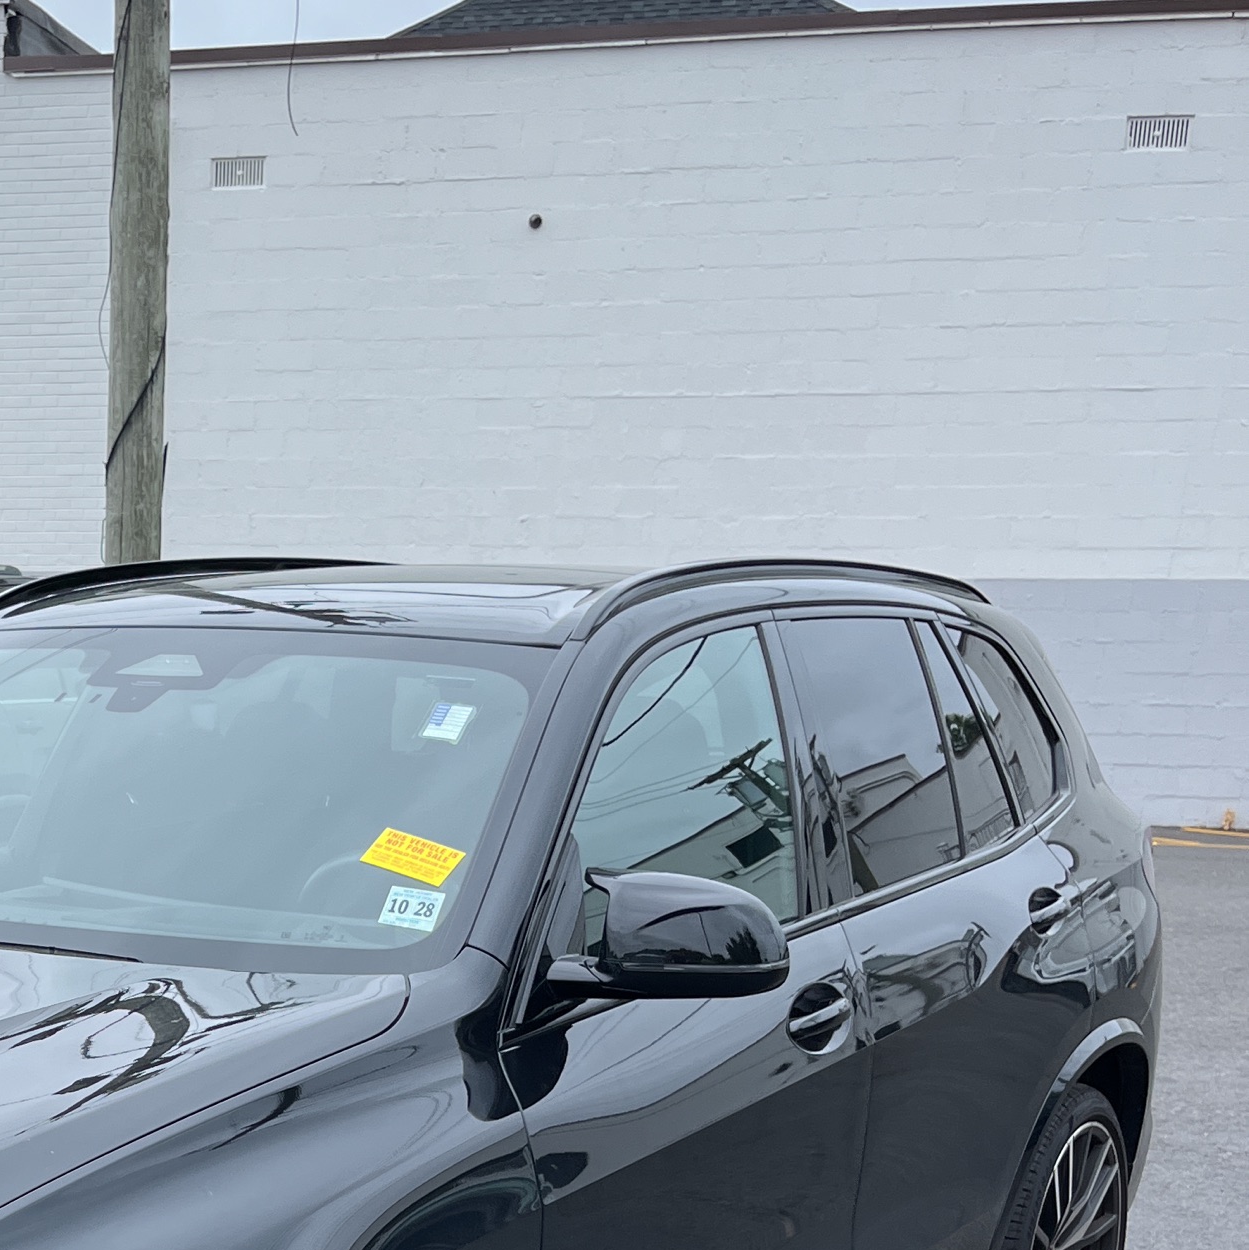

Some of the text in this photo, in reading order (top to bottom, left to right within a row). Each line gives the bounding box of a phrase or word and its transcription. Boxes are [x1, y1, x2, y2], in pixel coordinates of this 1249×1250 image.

[385, 838, 405, 848] NOT
[406, 845, 425, 855] FOR
[426, 852, 450, 863] SALE
[387, 831, 460, 859] THIS VEHICLE IS
[388, 898, 435, 918] 10 28
